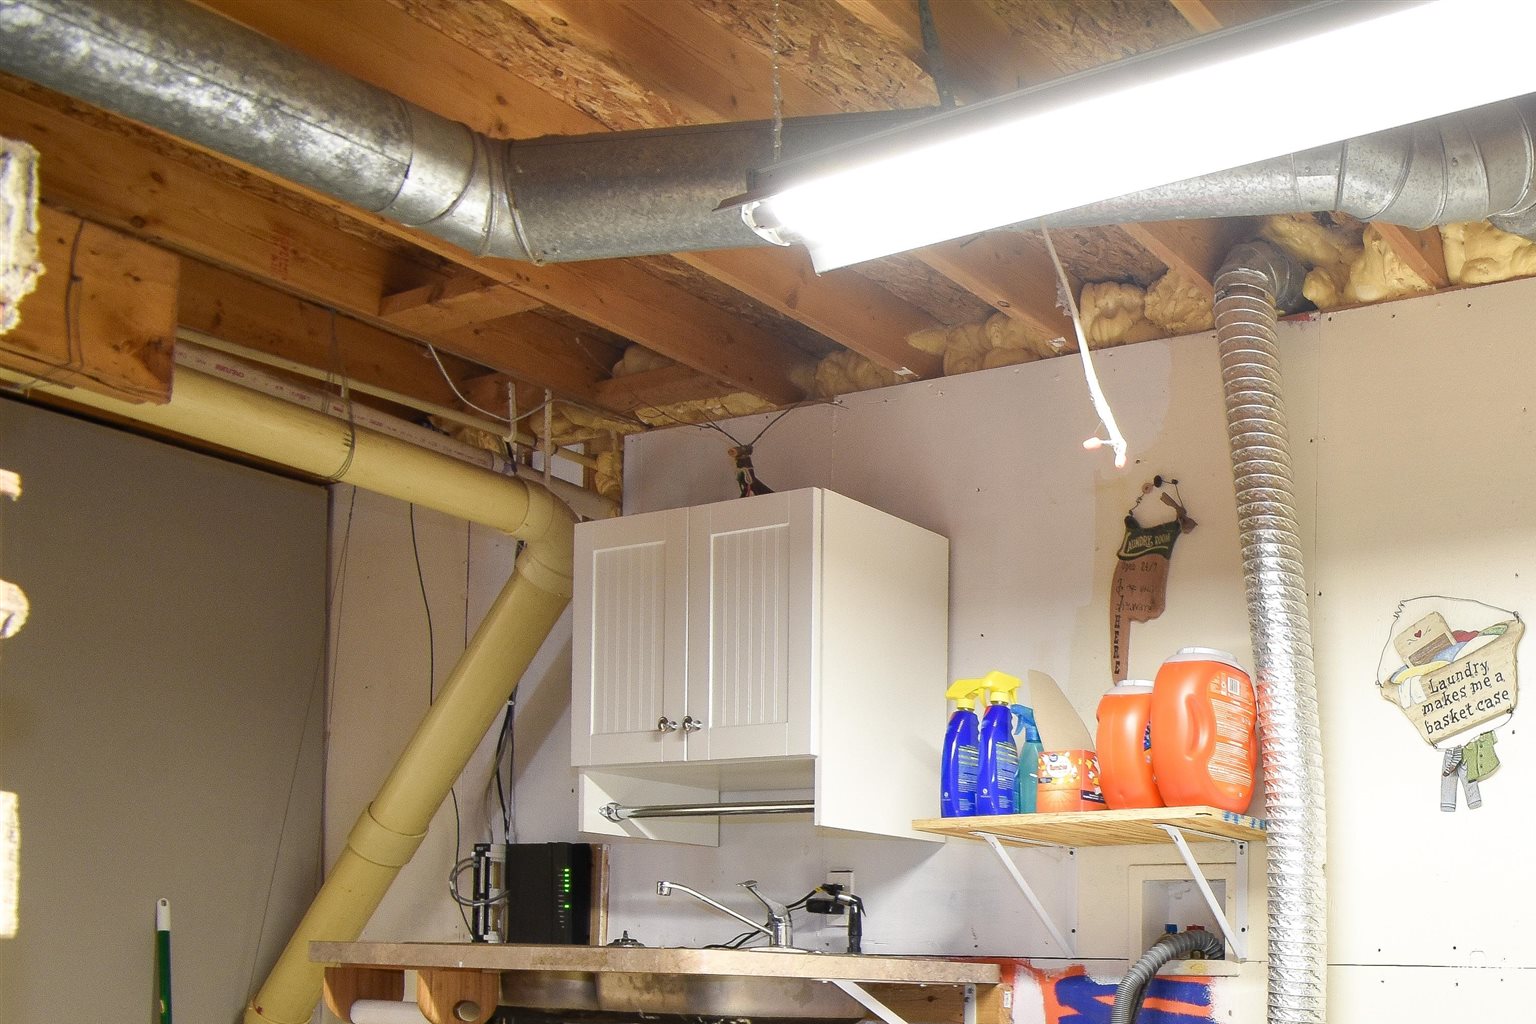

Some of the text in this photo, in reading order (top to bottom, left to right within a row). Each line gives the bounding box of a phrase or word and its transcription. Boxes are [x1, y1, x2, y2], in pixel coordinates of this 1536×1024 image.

[1422, 672, 1505, 715] makes me a
[1429, 661, 1489, 694] Laundry
[1425, 690, 1509, 734] basket case
